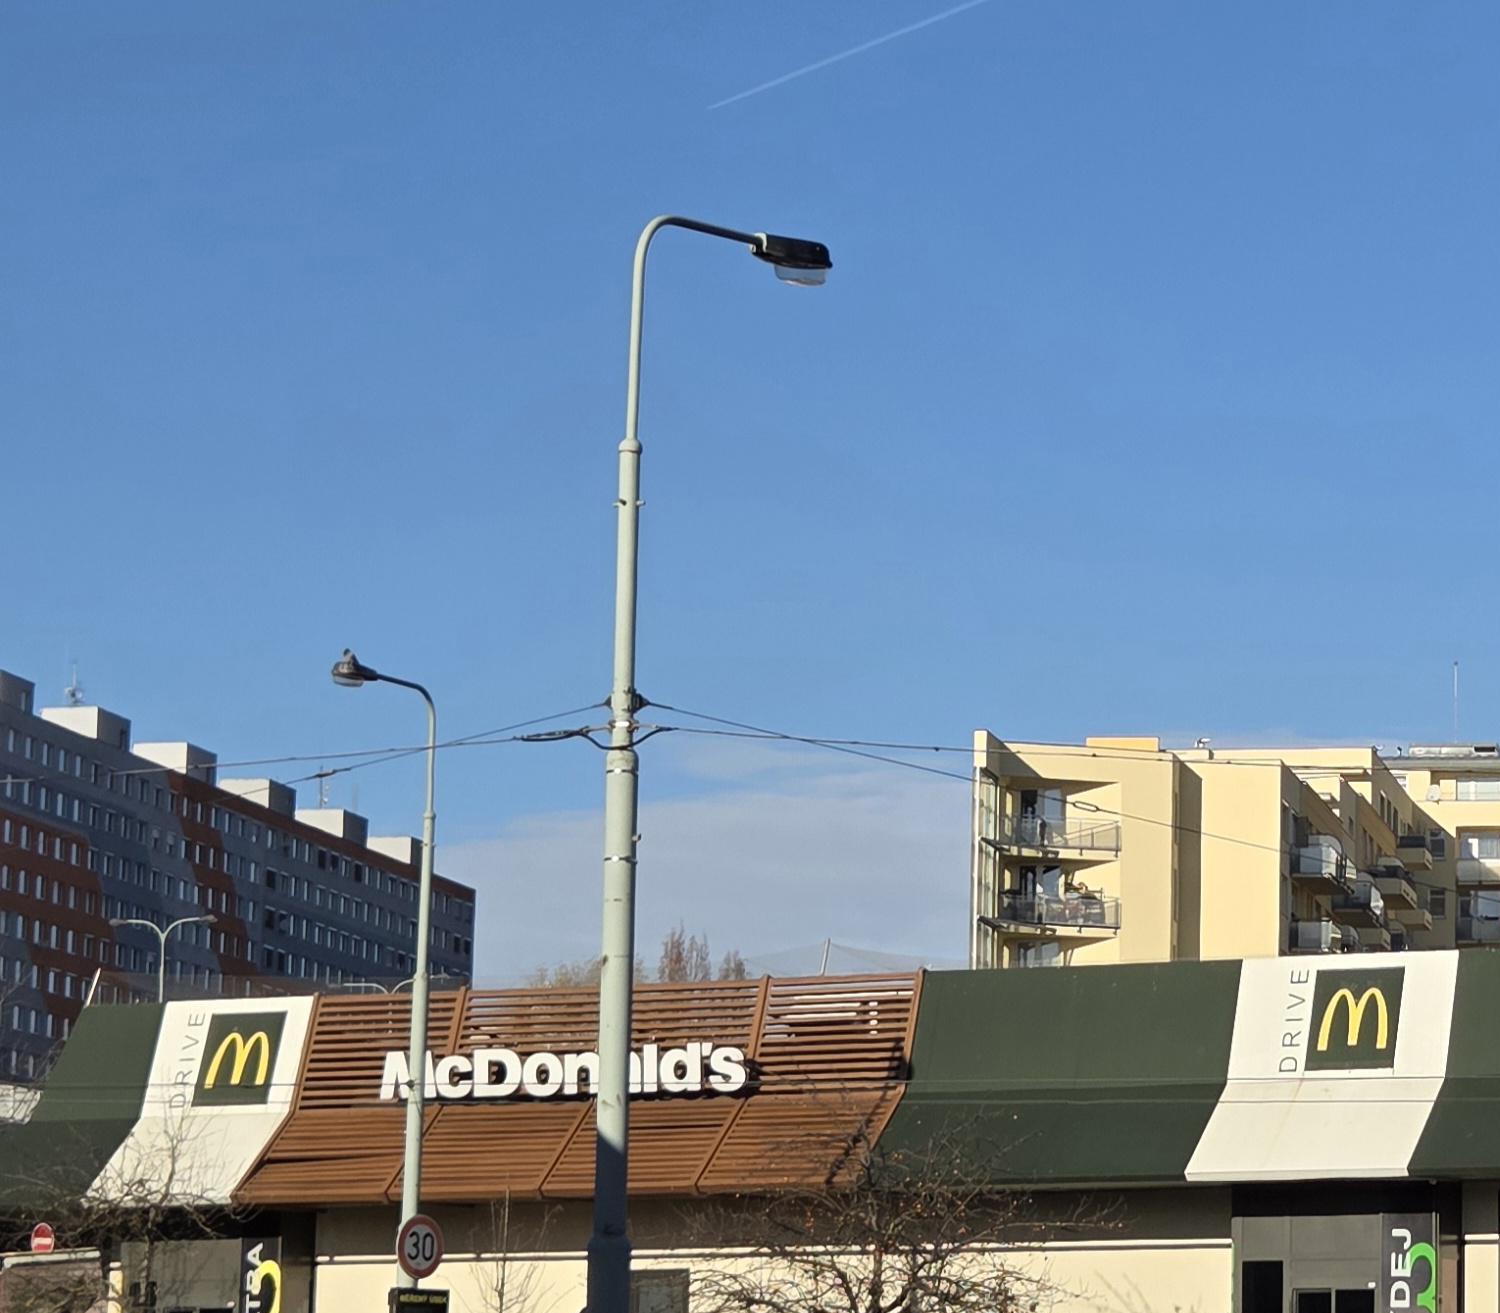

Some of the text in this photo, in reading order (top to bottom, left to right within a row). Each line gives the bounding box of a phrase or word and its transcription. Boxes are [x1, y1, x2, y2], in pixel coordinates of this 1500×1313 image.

[1279, 968, 1309, 1073] DRIVE
[168, 1012, 206, 1109] DRIVE
[379, 1041, 747, 1100] McDonld's
[407, 1230, 435, 1262] 30
